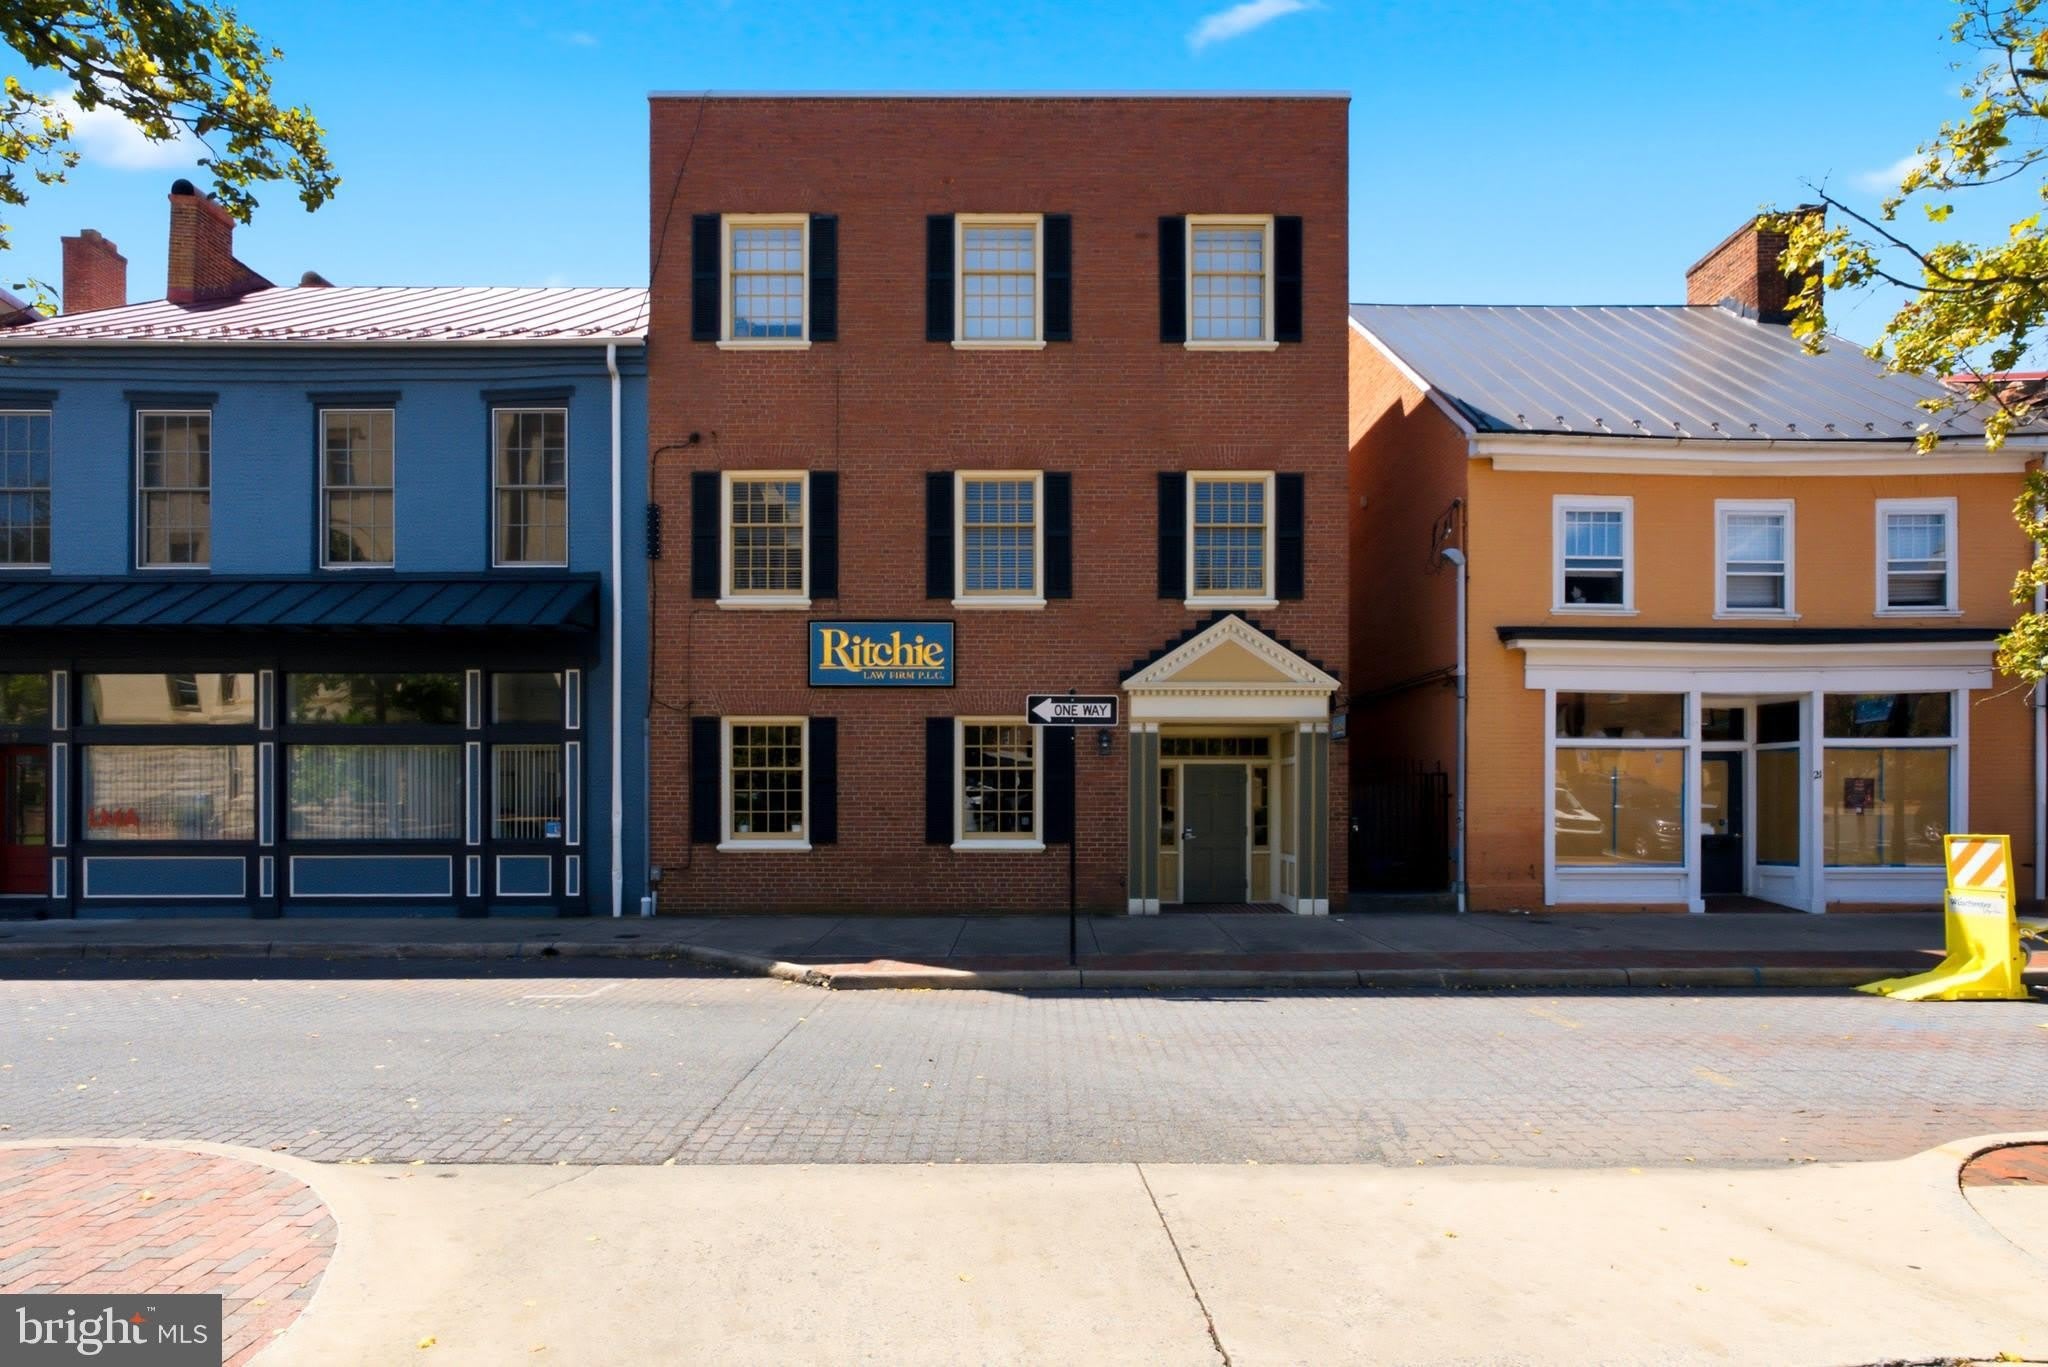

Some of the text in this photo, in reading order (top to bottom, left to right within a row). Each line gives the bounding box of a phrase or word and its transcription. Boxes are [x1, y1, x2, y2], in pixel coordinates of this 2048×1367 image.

[820, 629, 945, 672] Ritchie
[863, 671, 886, 680] LAW
[889, 671, 915, 680] FIRM
[1054, 704, 1107, 717] ONE WAY
